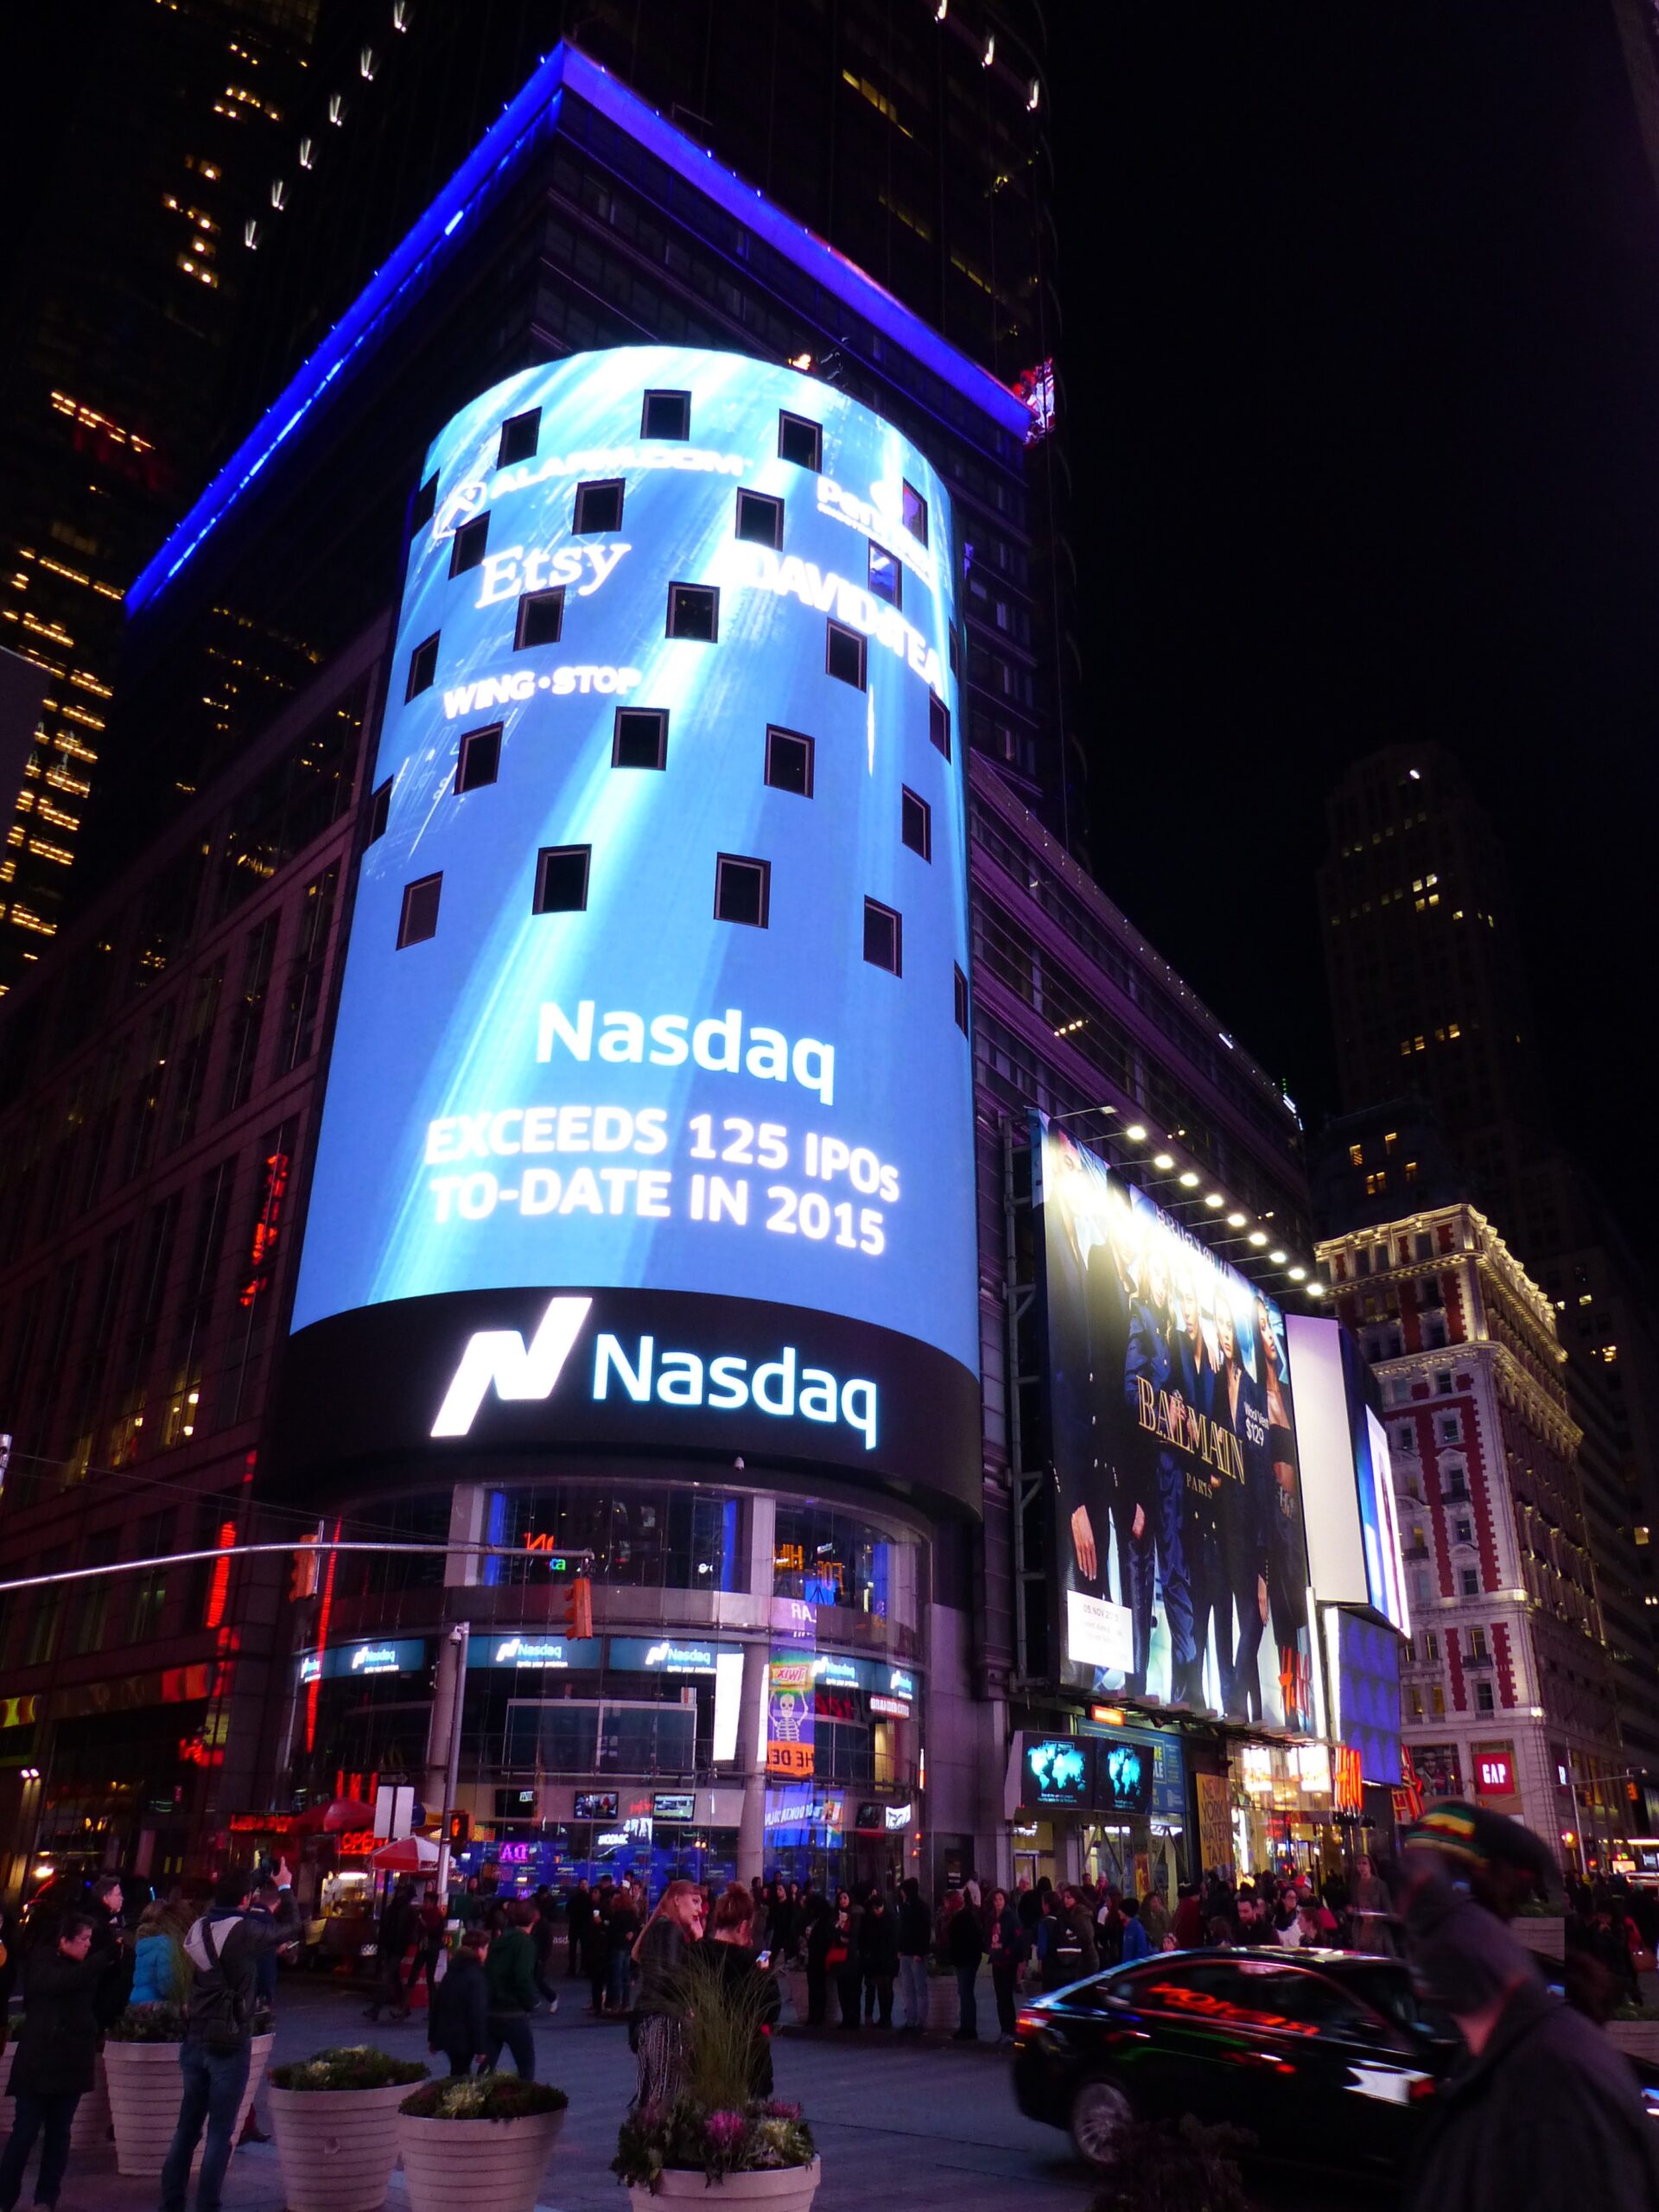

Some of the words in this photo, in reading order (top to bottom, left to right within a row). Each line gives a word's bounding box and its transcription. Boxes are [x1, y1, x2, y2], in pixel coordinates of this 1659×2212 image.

[475, 543, 632, 609] Etsy
[537, 1000, 835, 1106] Nasdaq
[425, 1105, 668, 1165] EXCEEDS
[689, 1114, 789, 1169] 125
[804, 1132, 900, 1202] IPOs
[430, 1166, 672, 1224] TO-DATE
[690, 1173, 748, 1225] IN
[766, 1186, 886, 1256] 2015
[593, 1332, 878, 1451] Nasdaq
[1135, 1375, 1245, 1486] BALMAIN
[1245, 1416, 1265, 1447] $129
[1185, 1471, 1213, 1500] PARIS
[518, 1643, 562, 1659] Nasdaq
[668, 1649, 711, 1665] Nasdaq
[1482, 1764, 1506, 1784] GAP
[1201, 1800, 1225, 1821] YORK
[340, 1829, 389, 1853] OPE
[1201, 1821, 1230, 1843] WATER
